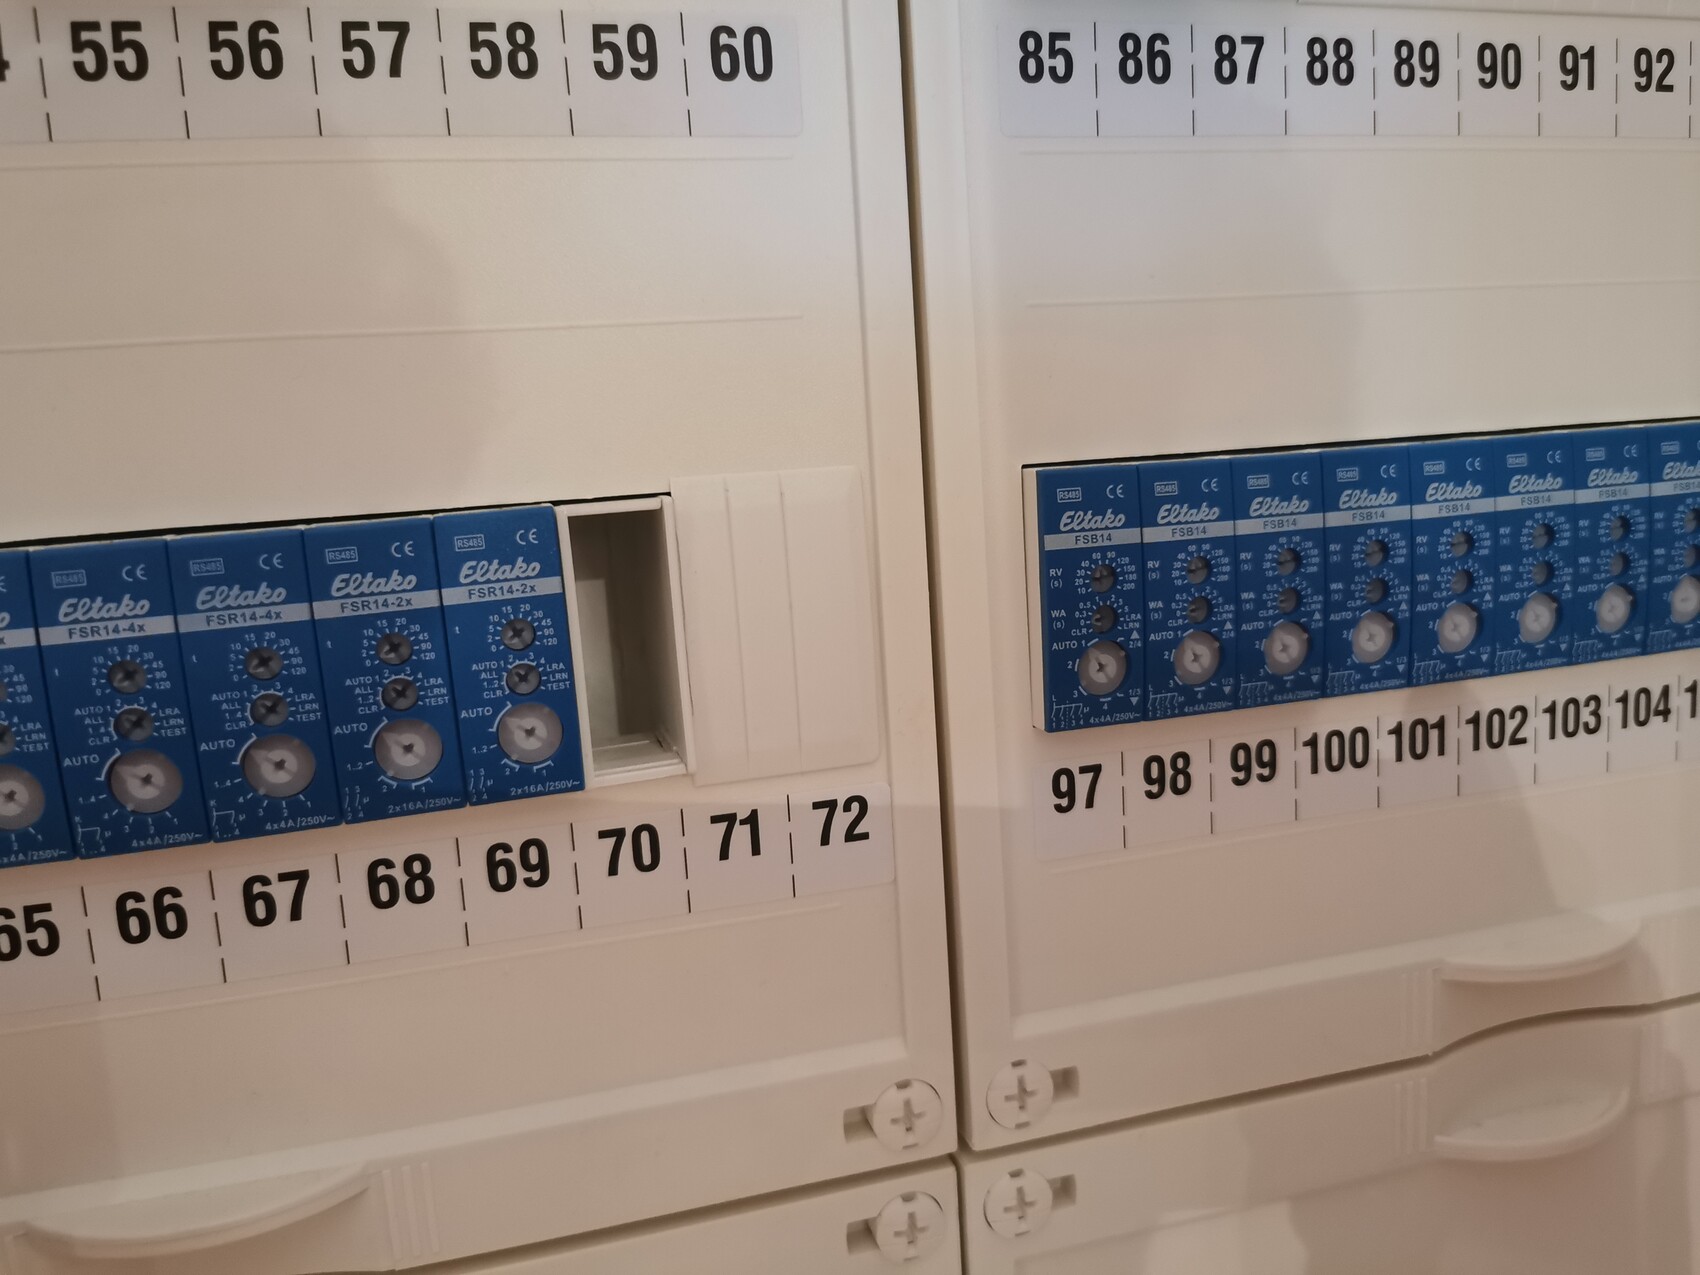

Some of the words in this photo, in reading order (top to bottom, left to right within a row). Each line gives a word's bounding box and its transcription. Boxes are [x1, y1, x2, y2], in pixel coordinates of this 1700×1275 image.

[70, 21, 149, 82] 55
[209, 20, 284, 80] 56
[341, 20, 411, 80] 57
[469, 22, 539, 80] 58
[591, 24, 659, 82] 59
[710, 26, 773, 82] 60
[1018, 30, 1074, 84] 85
[1118, 32, 1172, 85] 86
[1214, 35, 1265, 85] 87
[1306, 37, 1354, 86] 88
[1393, 39, 1440, 88] 89
[1477, 42, 1522, 90] 90
[1559, 45, 1597, 91] 91
[1634, 47, 1674, 93] 92
[1587, 467, 1638, 487] Eltako
[1508, 472, 1562, 494] Eltako
[1059, 491, 1080, 500] RS485
[1425, 480, 1482, 502] Eltako
[1339, 487, 1397, 509] Eltako
[1520, 494, 1551, 506] FSB14
[1249, 495, 1310, 517] Eltako
[1438, 502, 1470, 514] FSB14
[1157, 502, 1221, 524] Eltako
[1352, 510, 1385, 522] FSB14
[1059, 508, 1126, 531] Eltako
[1263, 518, 1297, 529] FSB14
[1171, 526, 1207, 537] FSB14
[457, 539, 483, 549] RS485
[1075, 534, 1112, 545] FSB14
[328, 551, 356, 560] RS485
[1147, 561, 1160, 569] RV
[459, 557, 541, 584] Eltako
[1049, 568, 1062, 577] RV
[1125, 573, 1137, 581] 180
[330, 569, 417, 597] Eltako
[196, 582, 287, 610] Eltako
[468, 584, 537, 600] FSR14-2x
[1499, 593, 1520, 602] AUTO
[58, 594, 151, 622] Eltako
[340, 596, 413, 613] FSR14-2x
[520, 603, 531, 611] 20
[1416, 602, 1438, 611] AUTO
[502, 606, 512, 614] 15
[533, 610, 544, 618] 30
[1051, 609, 1066, 618] WA
[206, 609, 282, 626] FSR14-4x
[1125, 613, 1142, 621] LRA
[1329, 611, 1352, 621] AUTO
[396, 618, 407, 626] 20
[1123, 621, 1140, 629] LRN
[1168, 619, 1183, 627] CLR
[1241, 621, 1265, 631] AUTO
[68, 623, 146, 640] FSR14-4x
[488, 625, 494, 633] 5
[1071, 628, 1087, 636] CLR
[1149, 631, 1174, 641] AUTO
[543, 638, 558, 646] 120
[1052, 640, 1078, 651] AUTO
[1129, 640, 1142, 648] 2/4
[420, 652, 435, 660] 120
[471, 662, 498, 671] AUTO
[547, 663, 566, 671] LRA
[345, 676, 372, 686] AUTO
[480, 672, 499, 680] ALL
[550, 672, 568, 681] LRN
[424, 677, 444, 686] LRA
[547, 682, 571, 691] TEST
[354, 686, 374, 694] ALL
[427, 687, 447, 695] LRN
[484, 691, 503, 699] CLR
[212, 691, 240, 701] AUTO
[295, 693, 316, 701] LRA
[221, 702, 241, 710] ALL
[298, 702, 319, 711] LRN
[425, 697, 450, 706] TEST
[159, 707, 180, 716] LRA
[358, 706, 379, 715] CLR
[460, 707, 493, 718] AUTO
[296, 712, 322, 722] TEST
[225, 721, 247, 731] CLR
[334, 723, 368, 735] AUTO
[200, 739, 236, 751] AUTO
[1051, 763, 1102, 813] 97
[1143, 751, 1192, 799] 98
[1230, 739, 1277, 786] 99
[1302, 726, 1369, 774] 100
[1387, 715, 1445, 762] 101
[1465, 705, 1528, 751] 102
[1542, 695, 1601, 740] 103
[1615, 684, 1671, 729] 104
[63, 754, 100, 767] AUTO
[115, 886, 189, 945] 66
[242, 869, 310, 927] 67
[366, 853, 435, 909] 68
[486, 838, 550, 892] 69
[598, 823, 661, 876] 70
[710, 808, 762, 861] 71
[812, 795, 870, 846] 72
